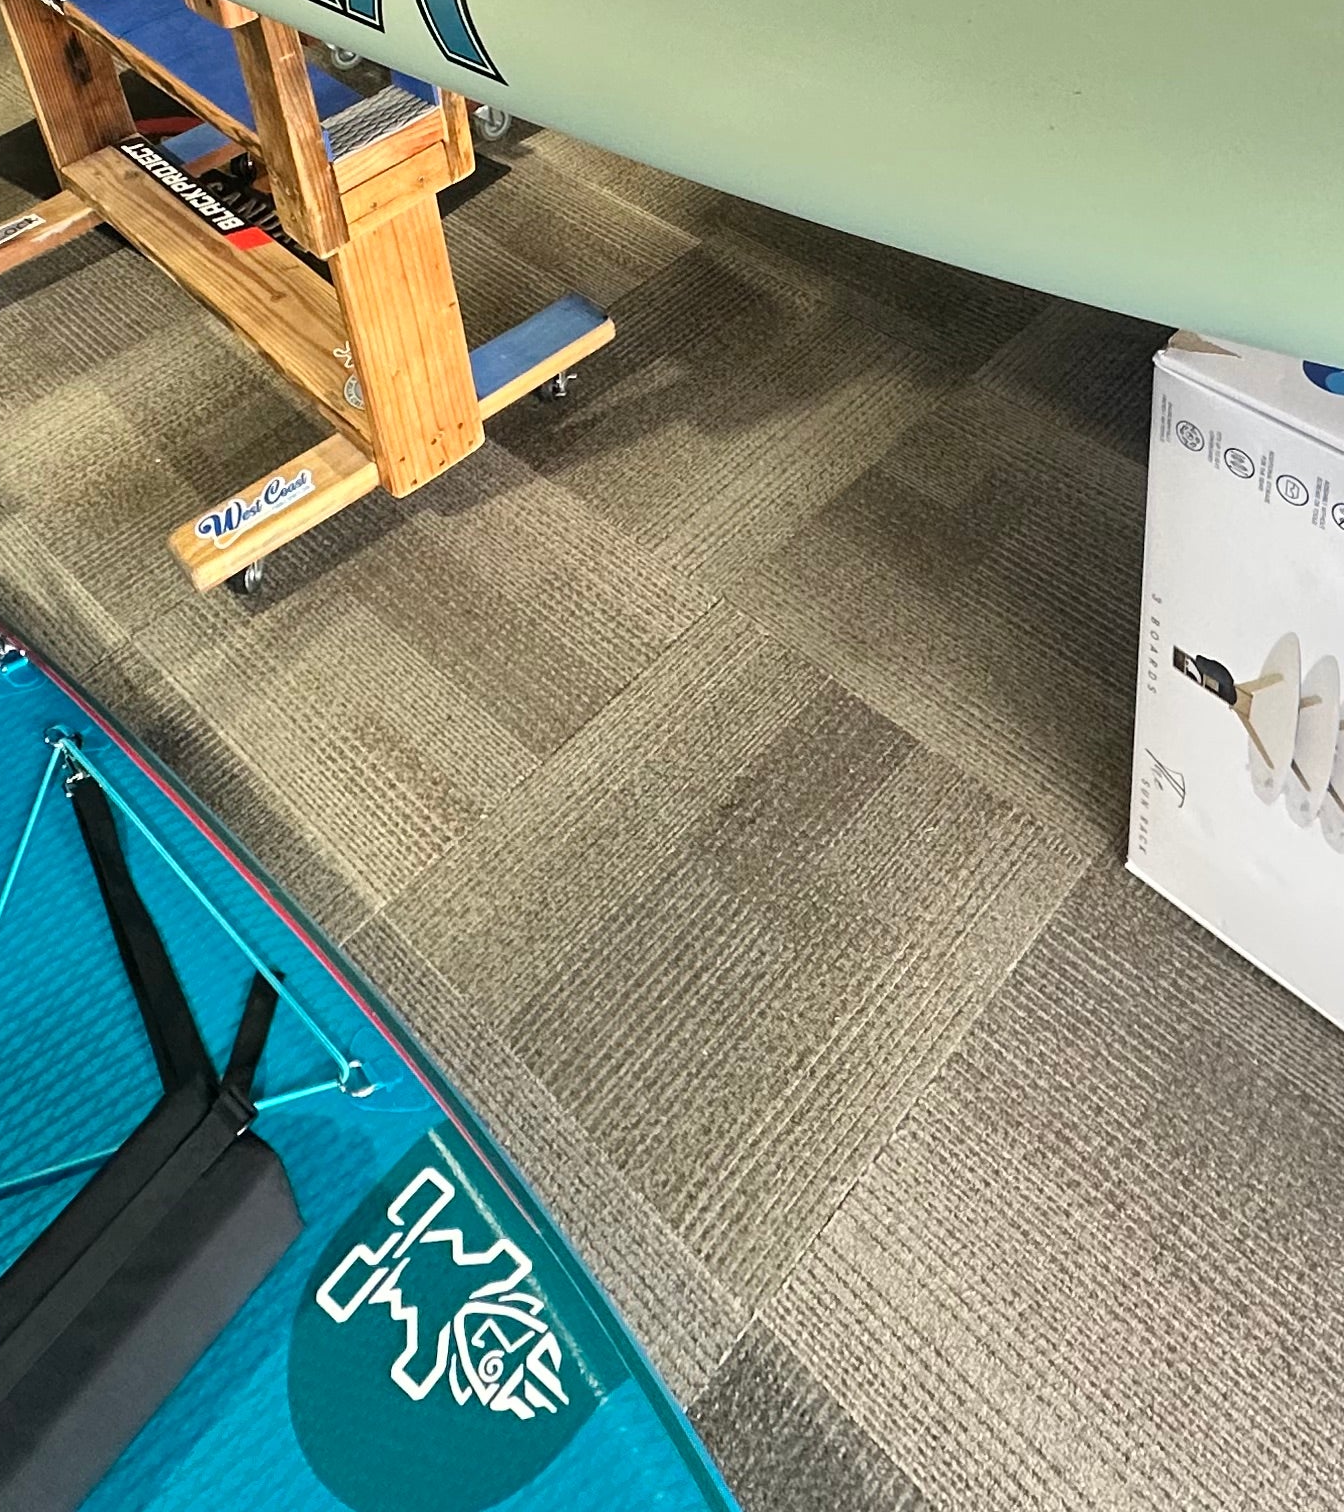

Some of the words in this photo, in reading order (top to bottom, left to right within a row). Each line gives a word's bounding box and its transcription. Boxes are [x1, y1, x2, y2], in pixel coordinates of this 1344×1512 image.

[198, 499, 263, 537] West
[263, 472, 308, 505] Coast
[1151, 592, 1163, 605] 3
[1147, 615, 1161, 694] BOARDS
